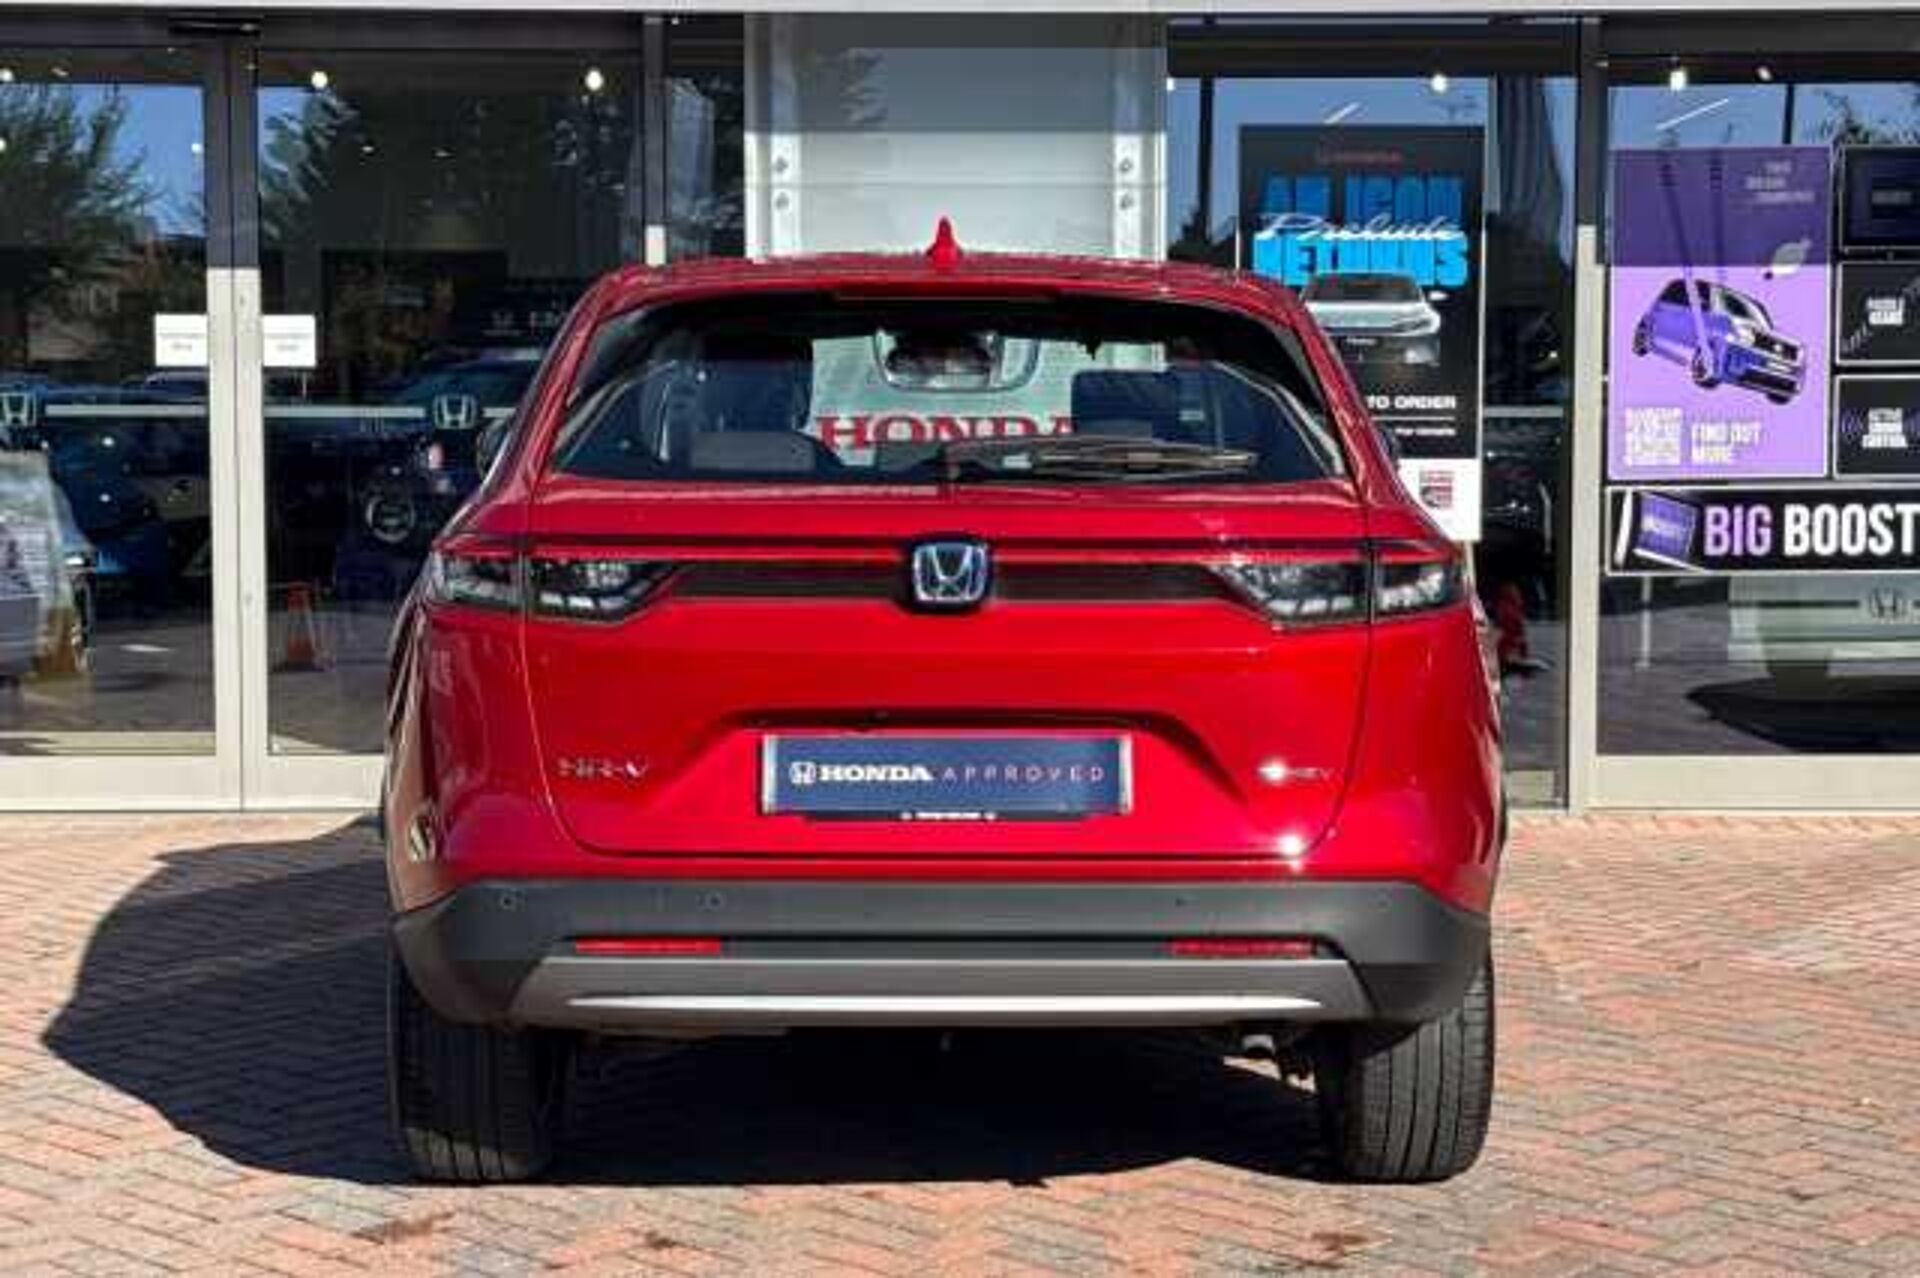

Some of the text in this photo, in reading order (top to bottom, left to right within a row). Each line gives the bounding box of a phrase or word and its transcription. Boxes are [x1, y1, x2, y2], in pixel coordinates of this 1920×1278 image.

[1366, 395, 1456, 409] TO ORDER
[1703, 505, 1773, 556] BIG
[1784, 504, 1920, 556] BOOST
[818, 766, 1105, 783] HONDA APPROVED
